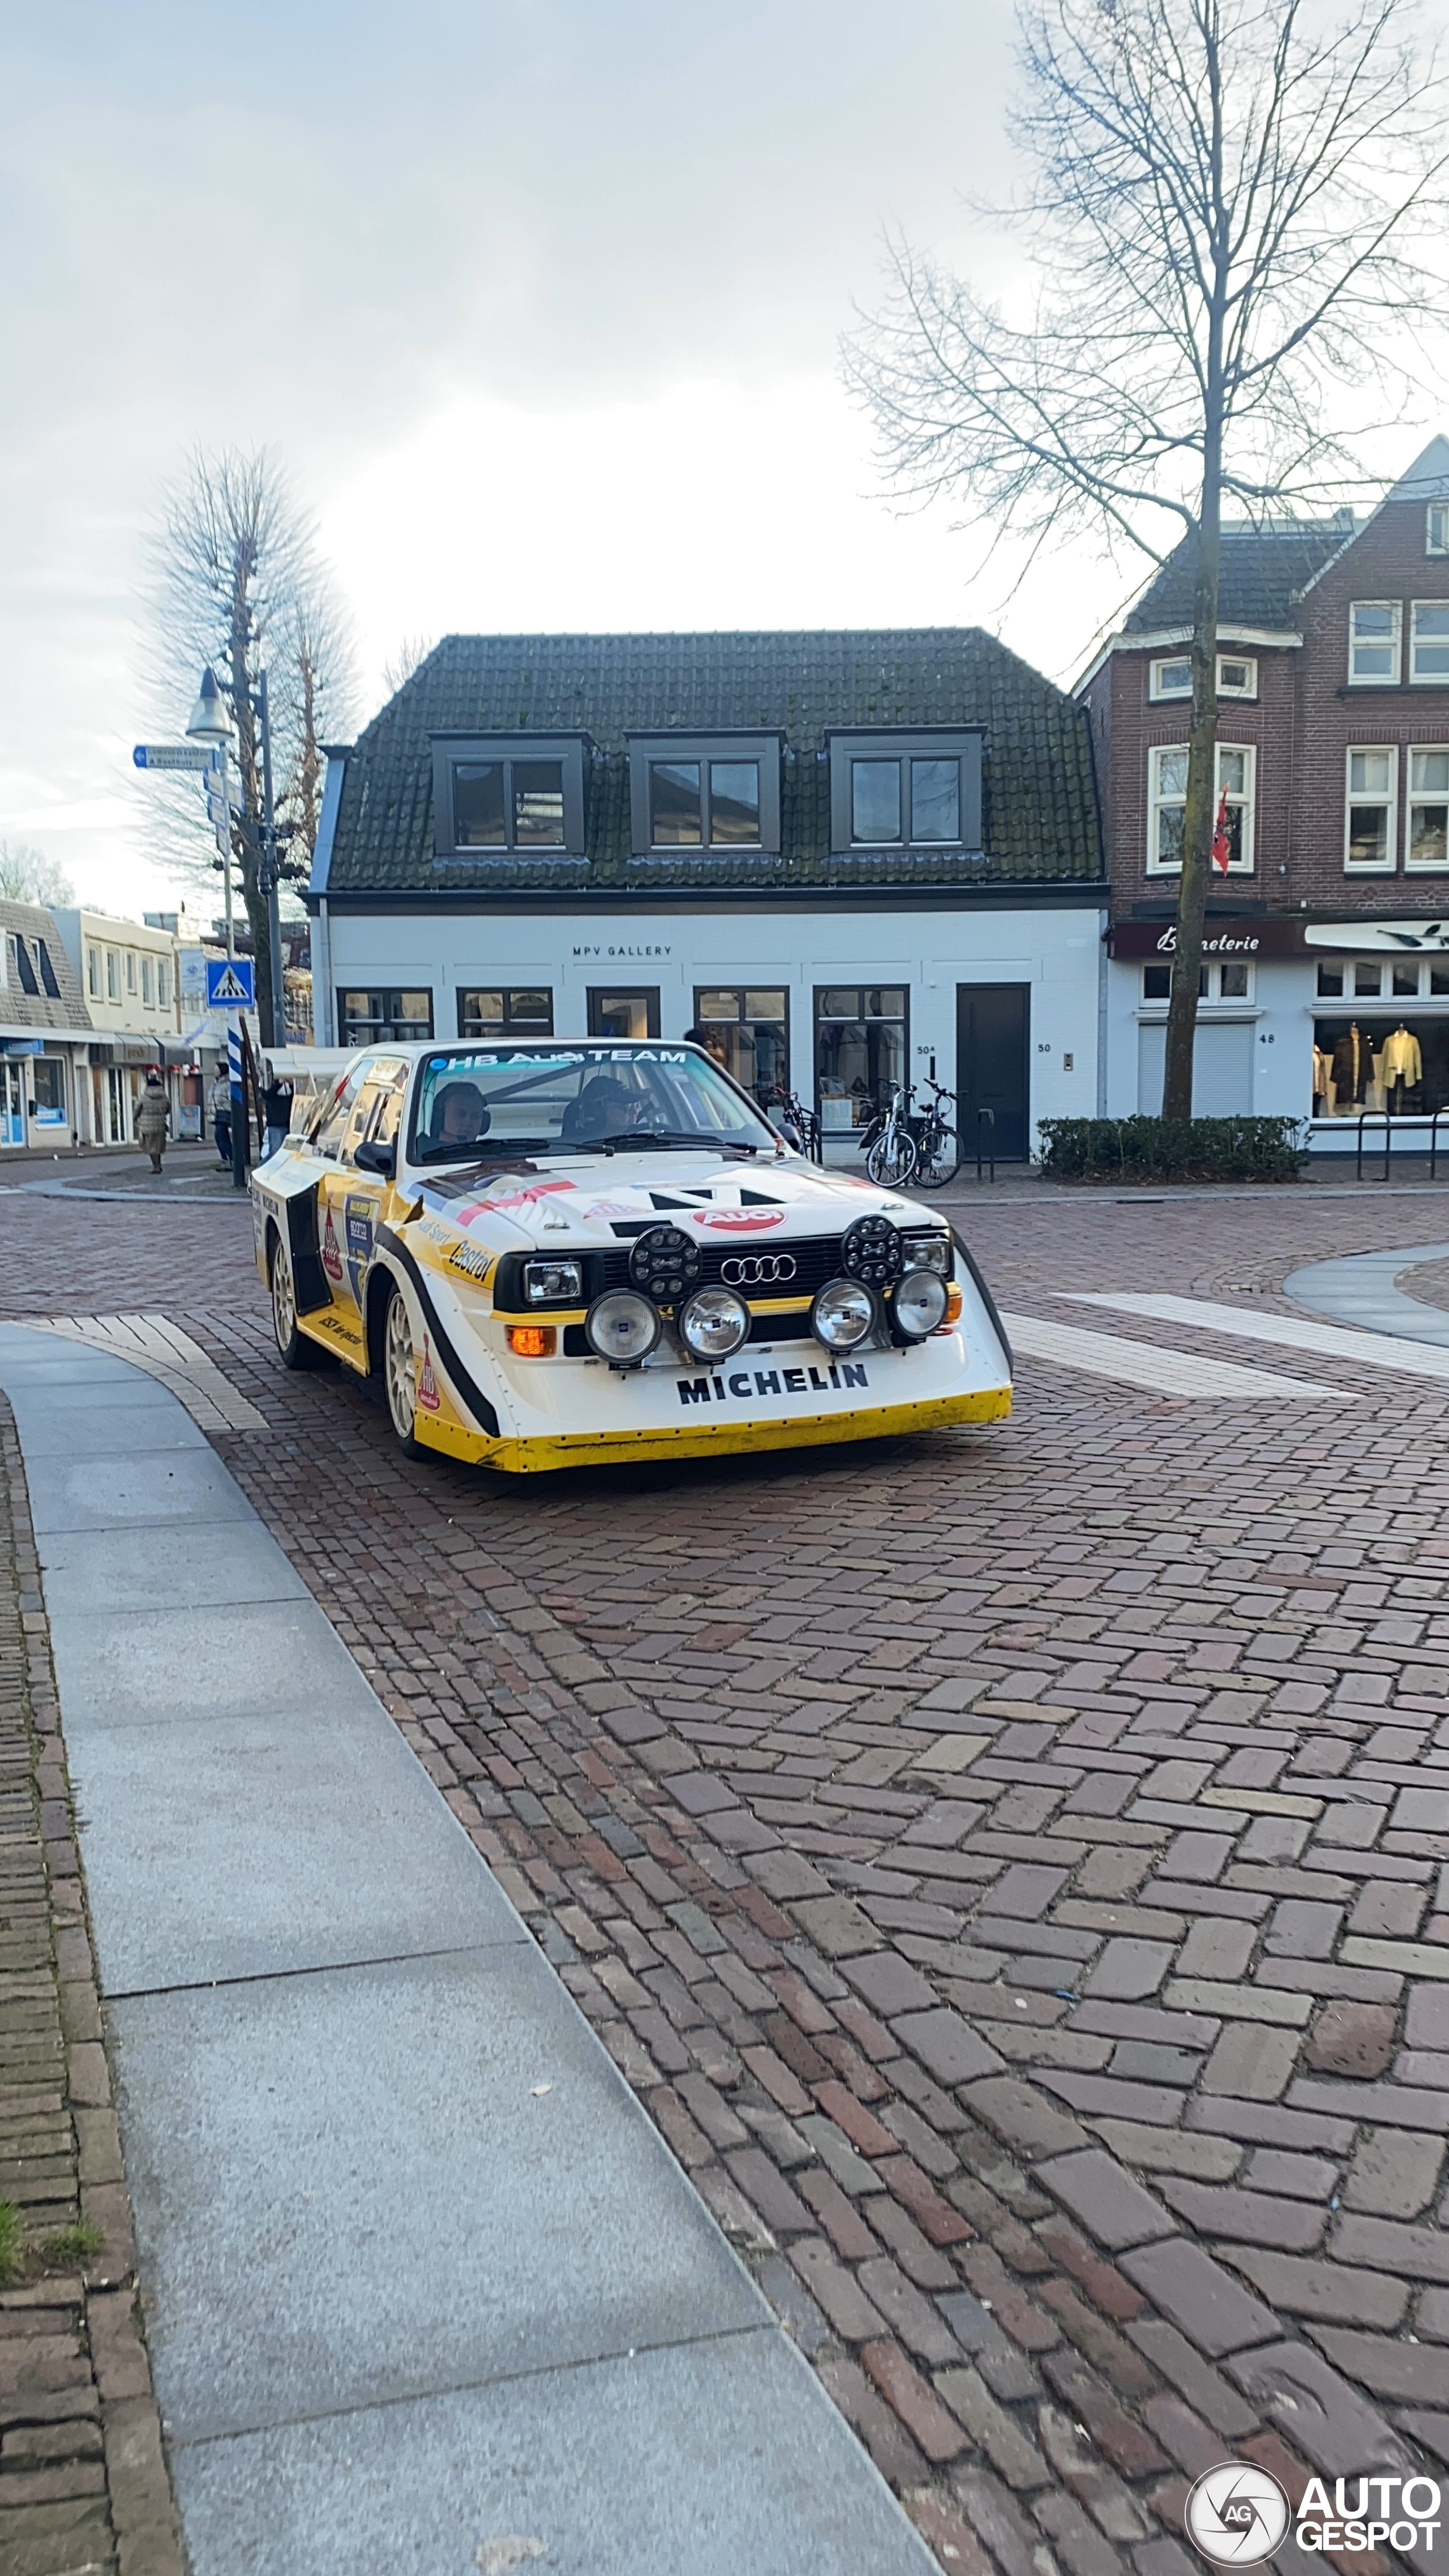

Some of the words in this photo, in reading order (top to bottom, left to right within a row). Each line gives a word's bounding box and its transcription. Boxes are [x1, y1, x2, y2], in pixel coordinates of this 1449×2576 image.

[1157, 926, 1259, 951] Bneterie
[573, 946, 600, 955] MPV
[608, 946, 671, 955] GALLERY
[1038, 1044, 1051, 1052] 50
[1260, 1034, 1275, 1043] 48
[448, 1054, 498, 1070] HB
[588, 1049, 686, 1063] TEAM
[428, 1224, 451, 1245] Sport
[449, 1240, 496, 1282] Castrol
[422, 1365, 435, 1395] HB
[676, 1364, 869, 1405] MICHELIN
